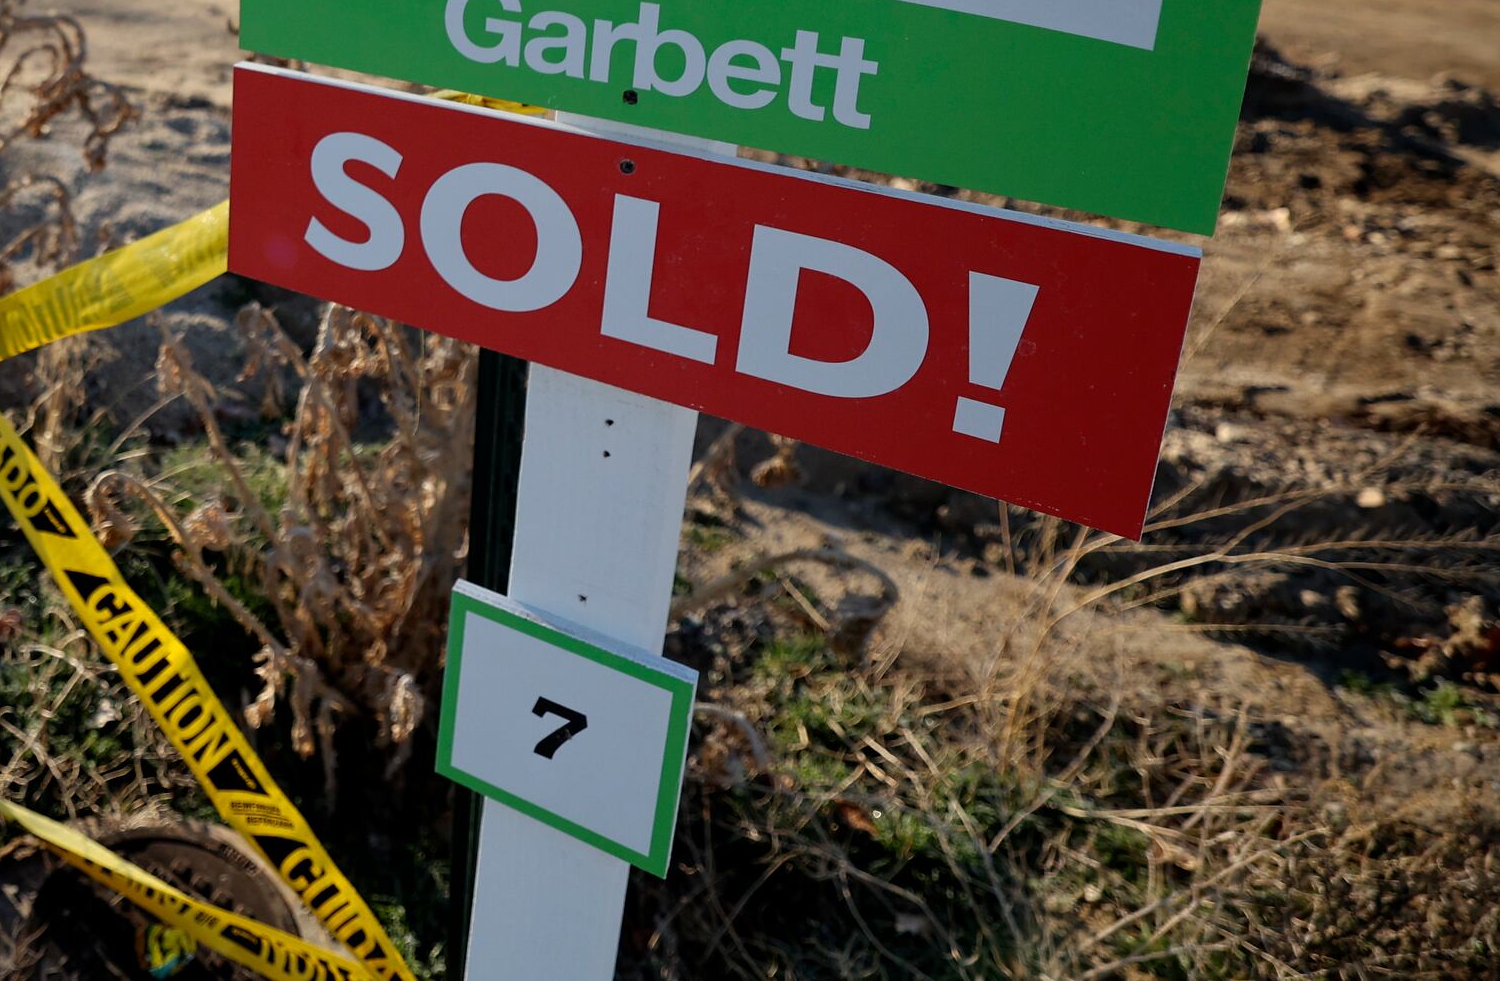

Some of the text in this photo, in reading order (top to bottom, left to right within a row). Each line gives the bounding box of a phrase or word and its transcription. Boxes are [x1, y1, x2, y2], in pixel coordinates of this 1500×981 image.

[303, 131, 1041, 444] SOLD!
[86, 583, 239, 775] CAUTION
[531, 695, 588, 760] 7
